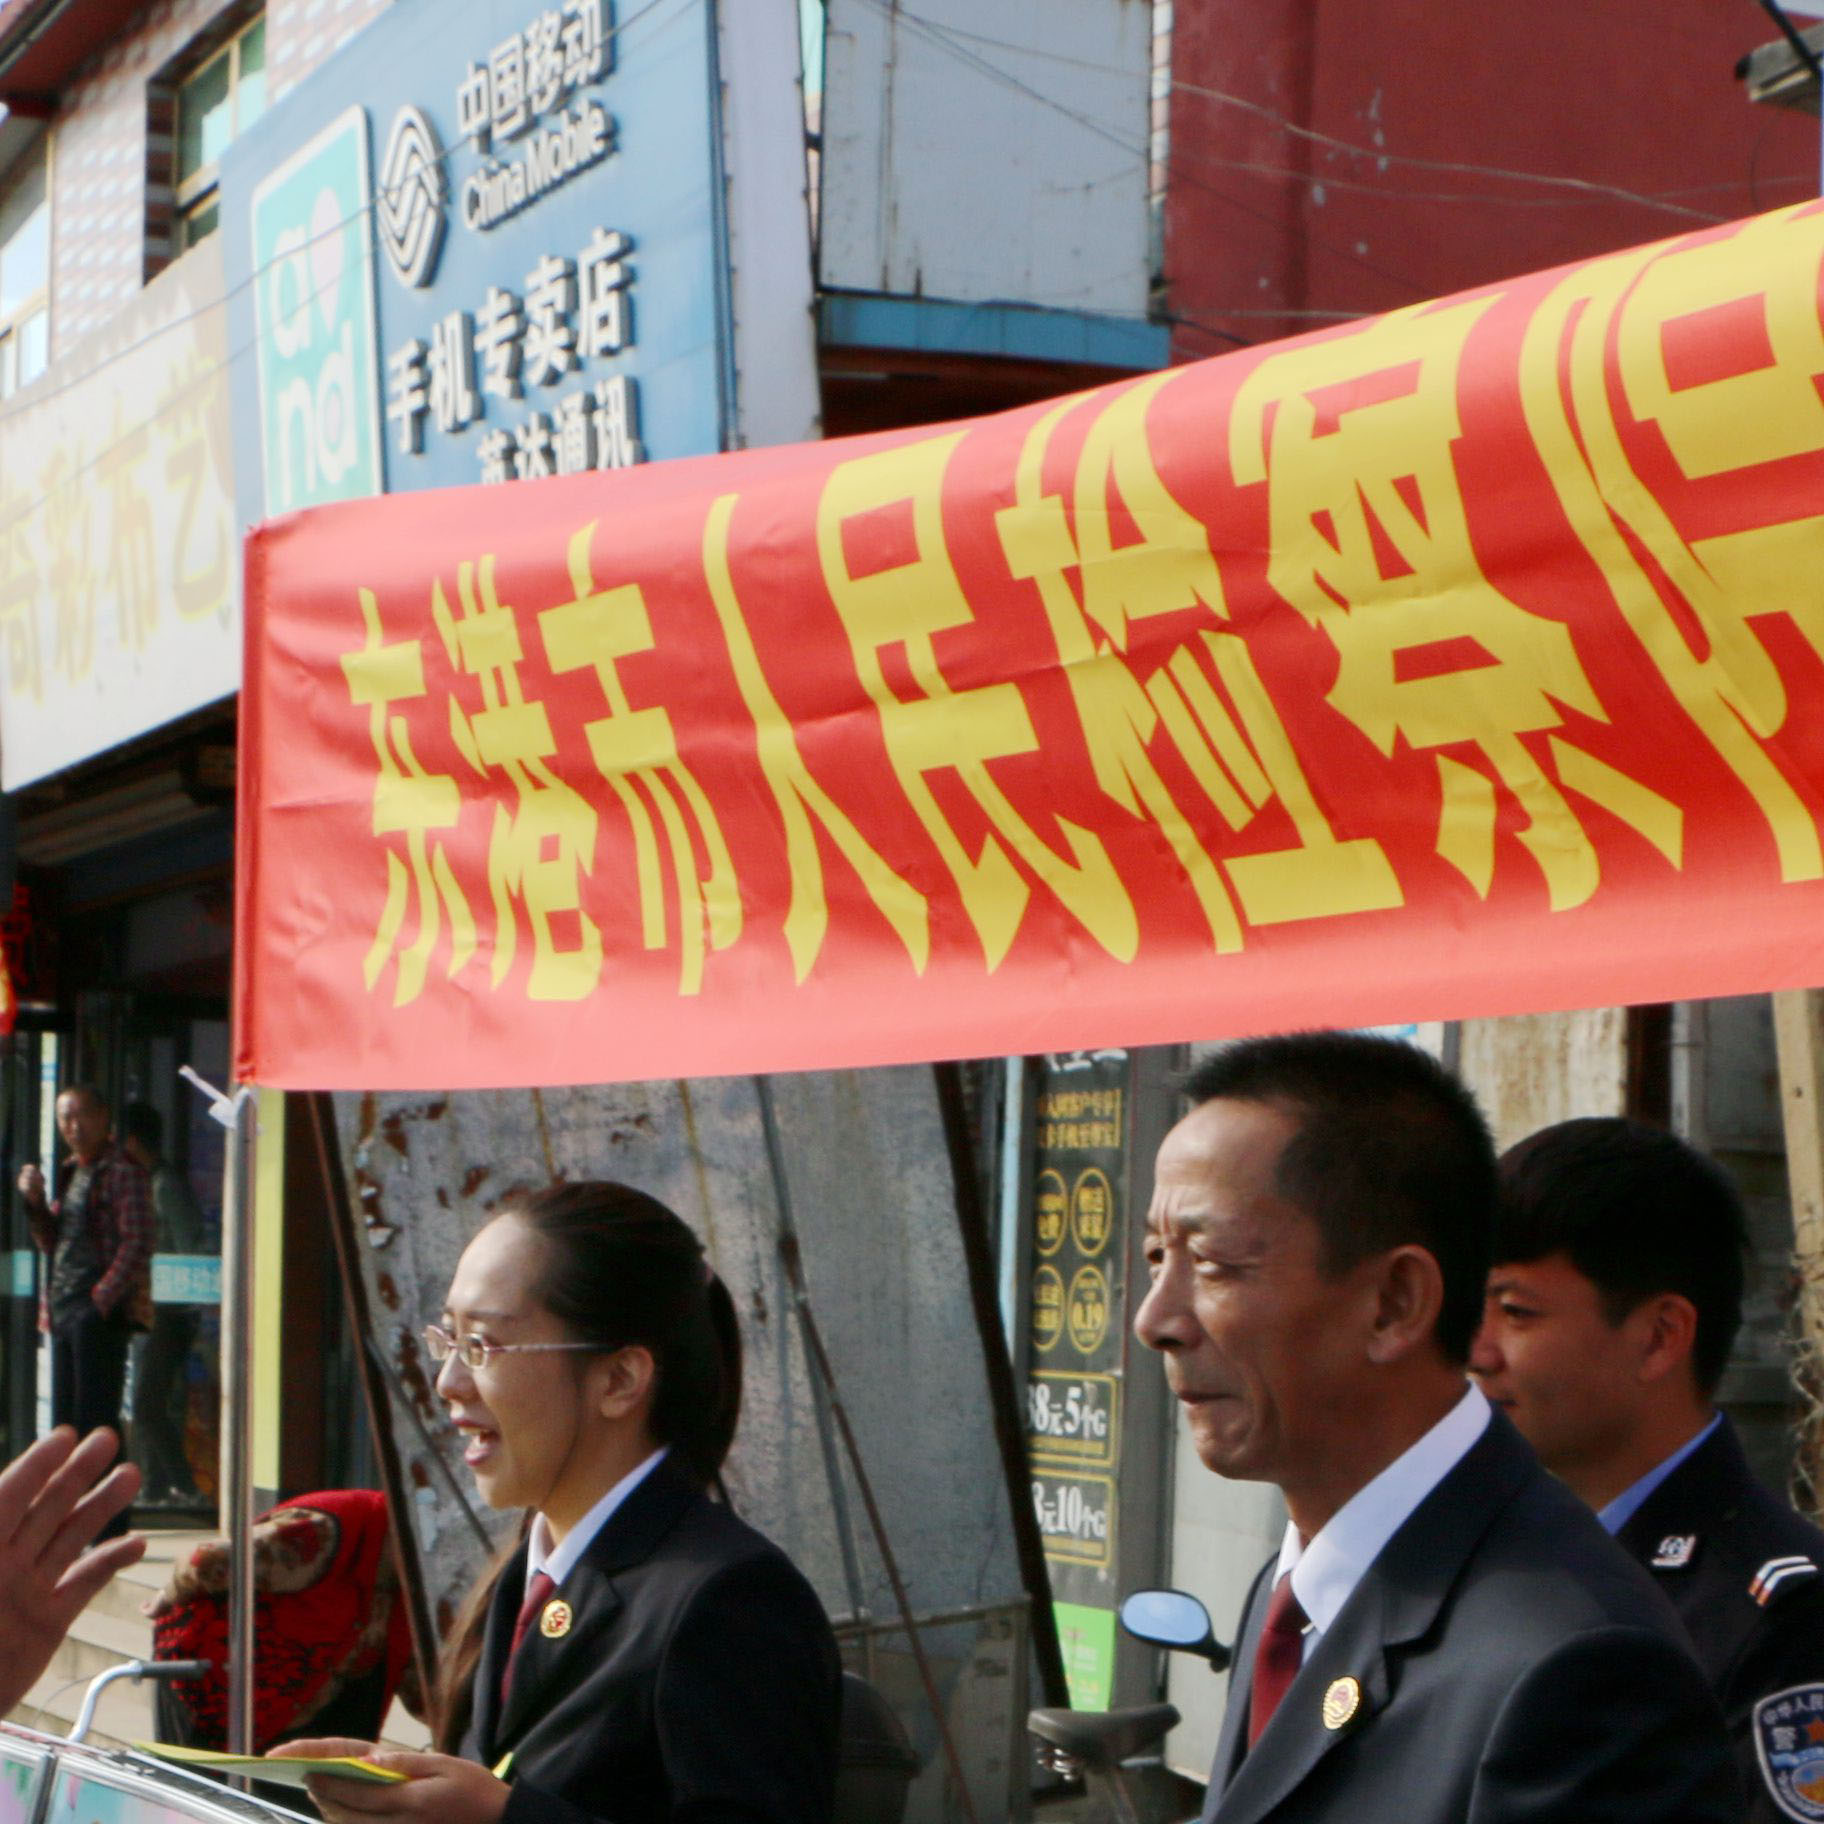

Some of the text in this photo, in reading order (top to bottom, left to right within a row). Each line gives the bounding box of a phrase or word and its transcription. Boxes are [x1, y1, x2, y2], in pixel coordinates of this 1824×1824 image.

[457, 0, 613, 152] 中国移动
[461, 99, 616, 231] China Mobile
[388, 226, 635, 454] 手机专卖店
